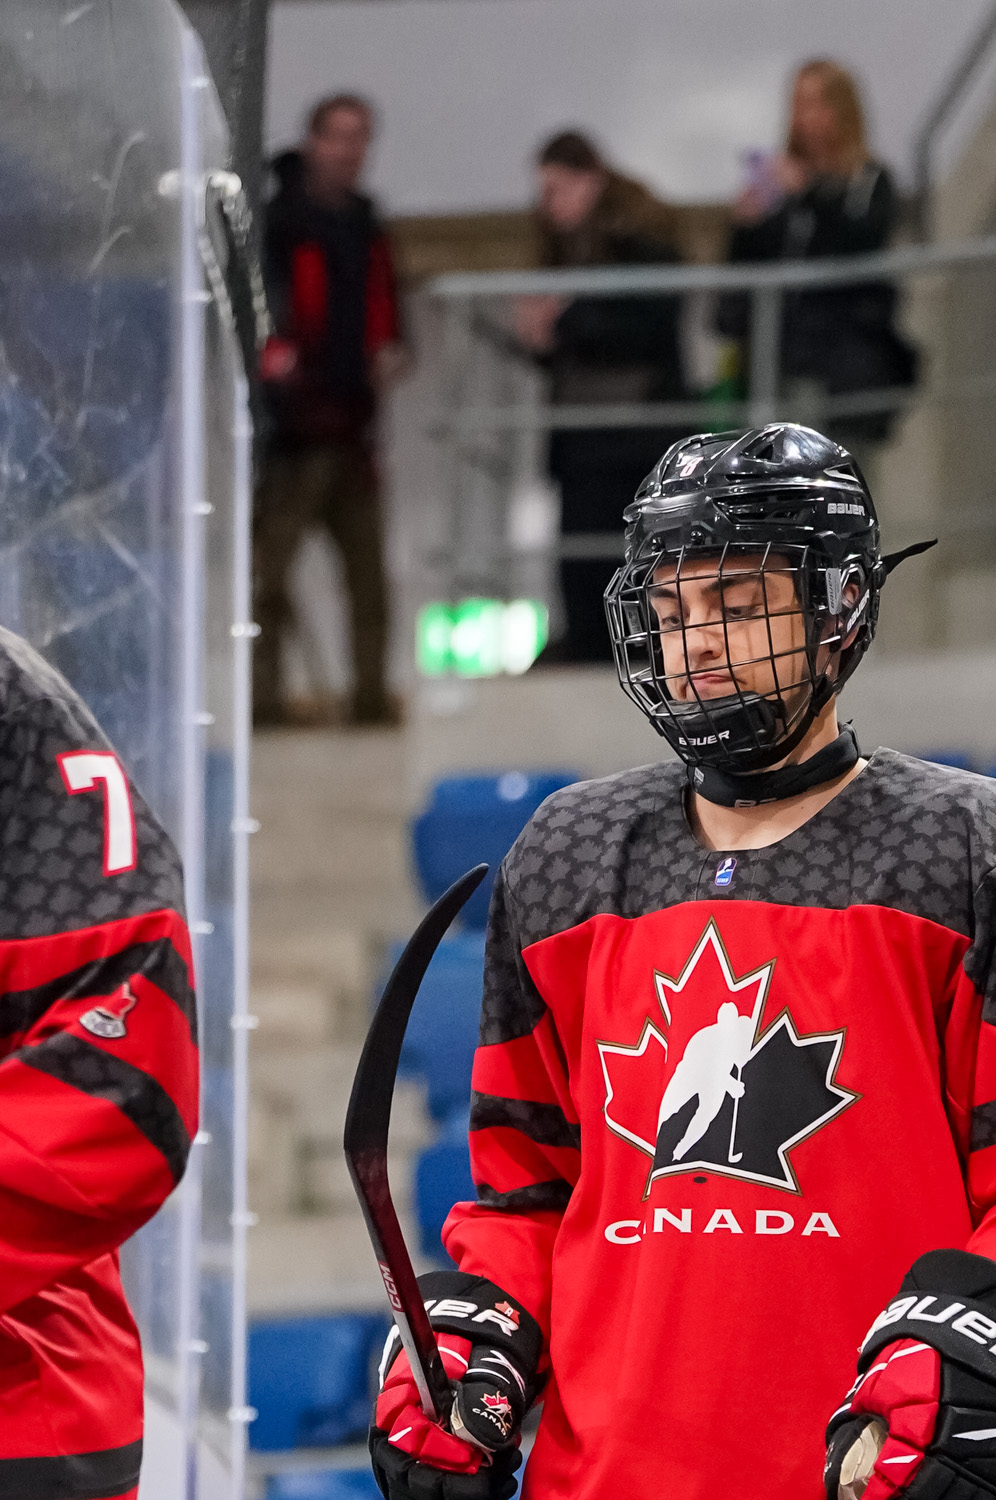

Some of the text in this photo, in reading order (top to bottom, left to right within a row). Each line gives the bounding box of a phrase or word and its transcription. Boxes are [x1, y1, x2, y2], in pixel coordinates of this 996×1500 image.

[678, 730, 730, 746] BAUER
[55, 749, 137, 877] 7
[604, 1208, 841, 1245] CNADA
[380, 1262, 404, 1312] CCM
[472, 1407, 508, 1438] CANAD
